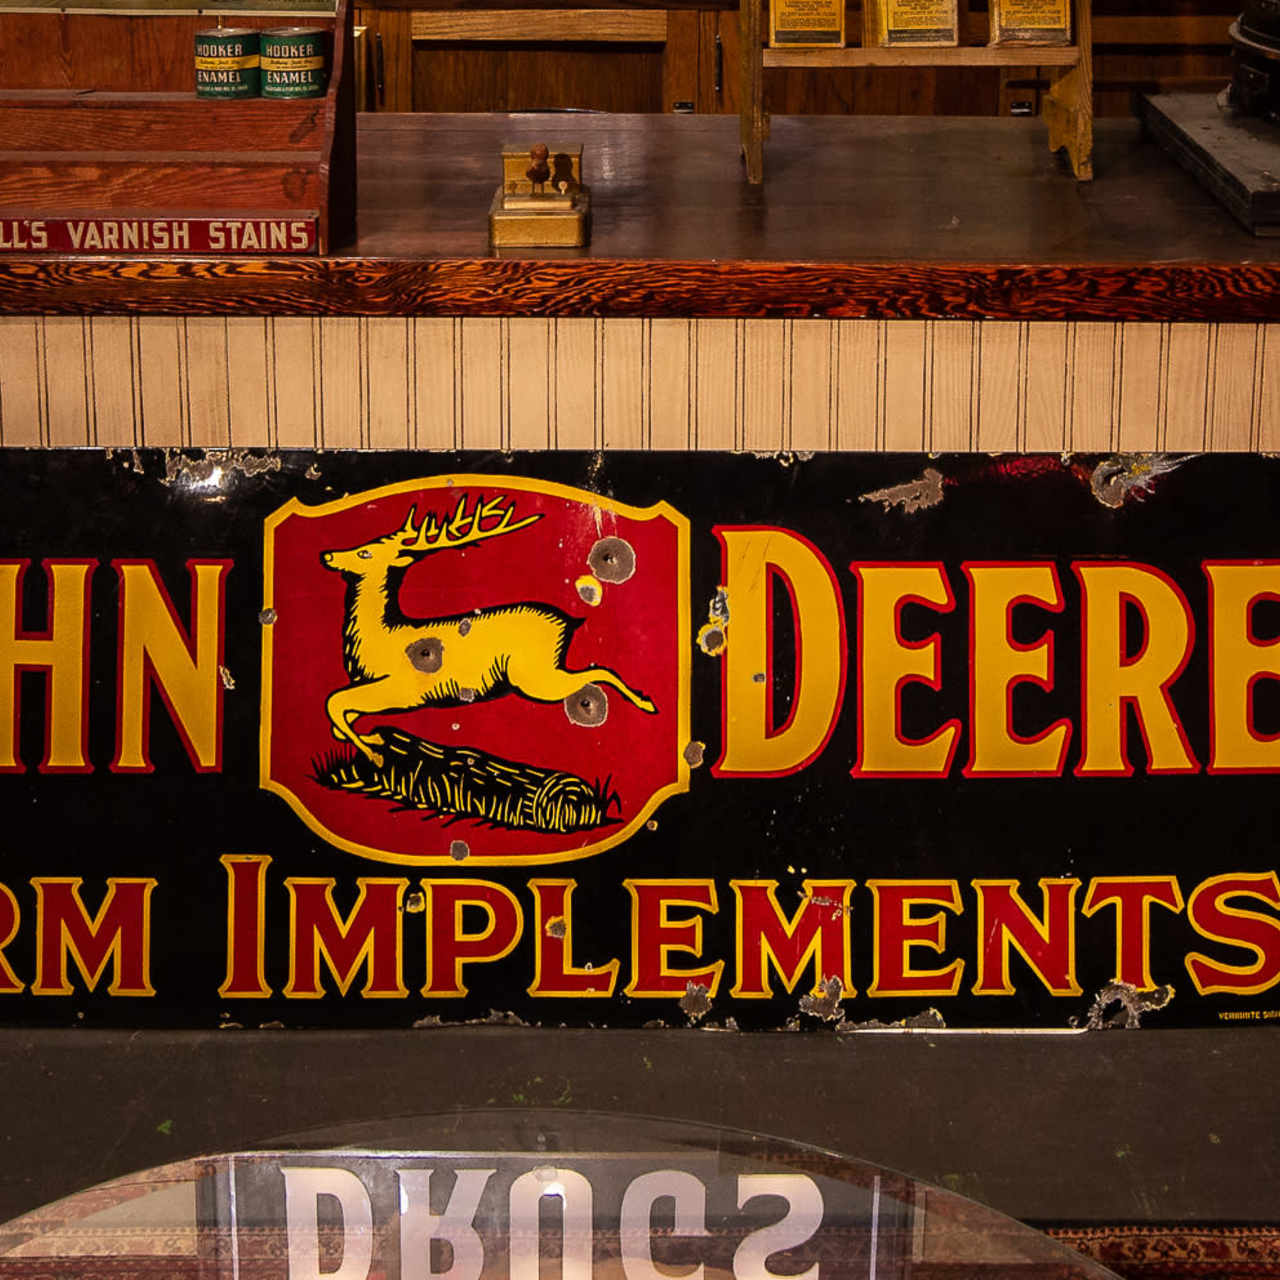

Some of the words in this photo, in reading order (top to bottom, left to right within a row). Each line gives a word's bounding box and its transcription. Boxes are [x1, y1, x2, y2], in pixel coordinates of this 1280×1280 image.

[197, 43, 242, 57] HOOKER
[266, 44, 314, 57] HOOKER
[198, 71, 241, 83] ENAMEL
[267, 71, 313, 84] ENAMEL
[67, 222, 190, 249] VARNISH
[209, 222, 309, 249] STAINS
